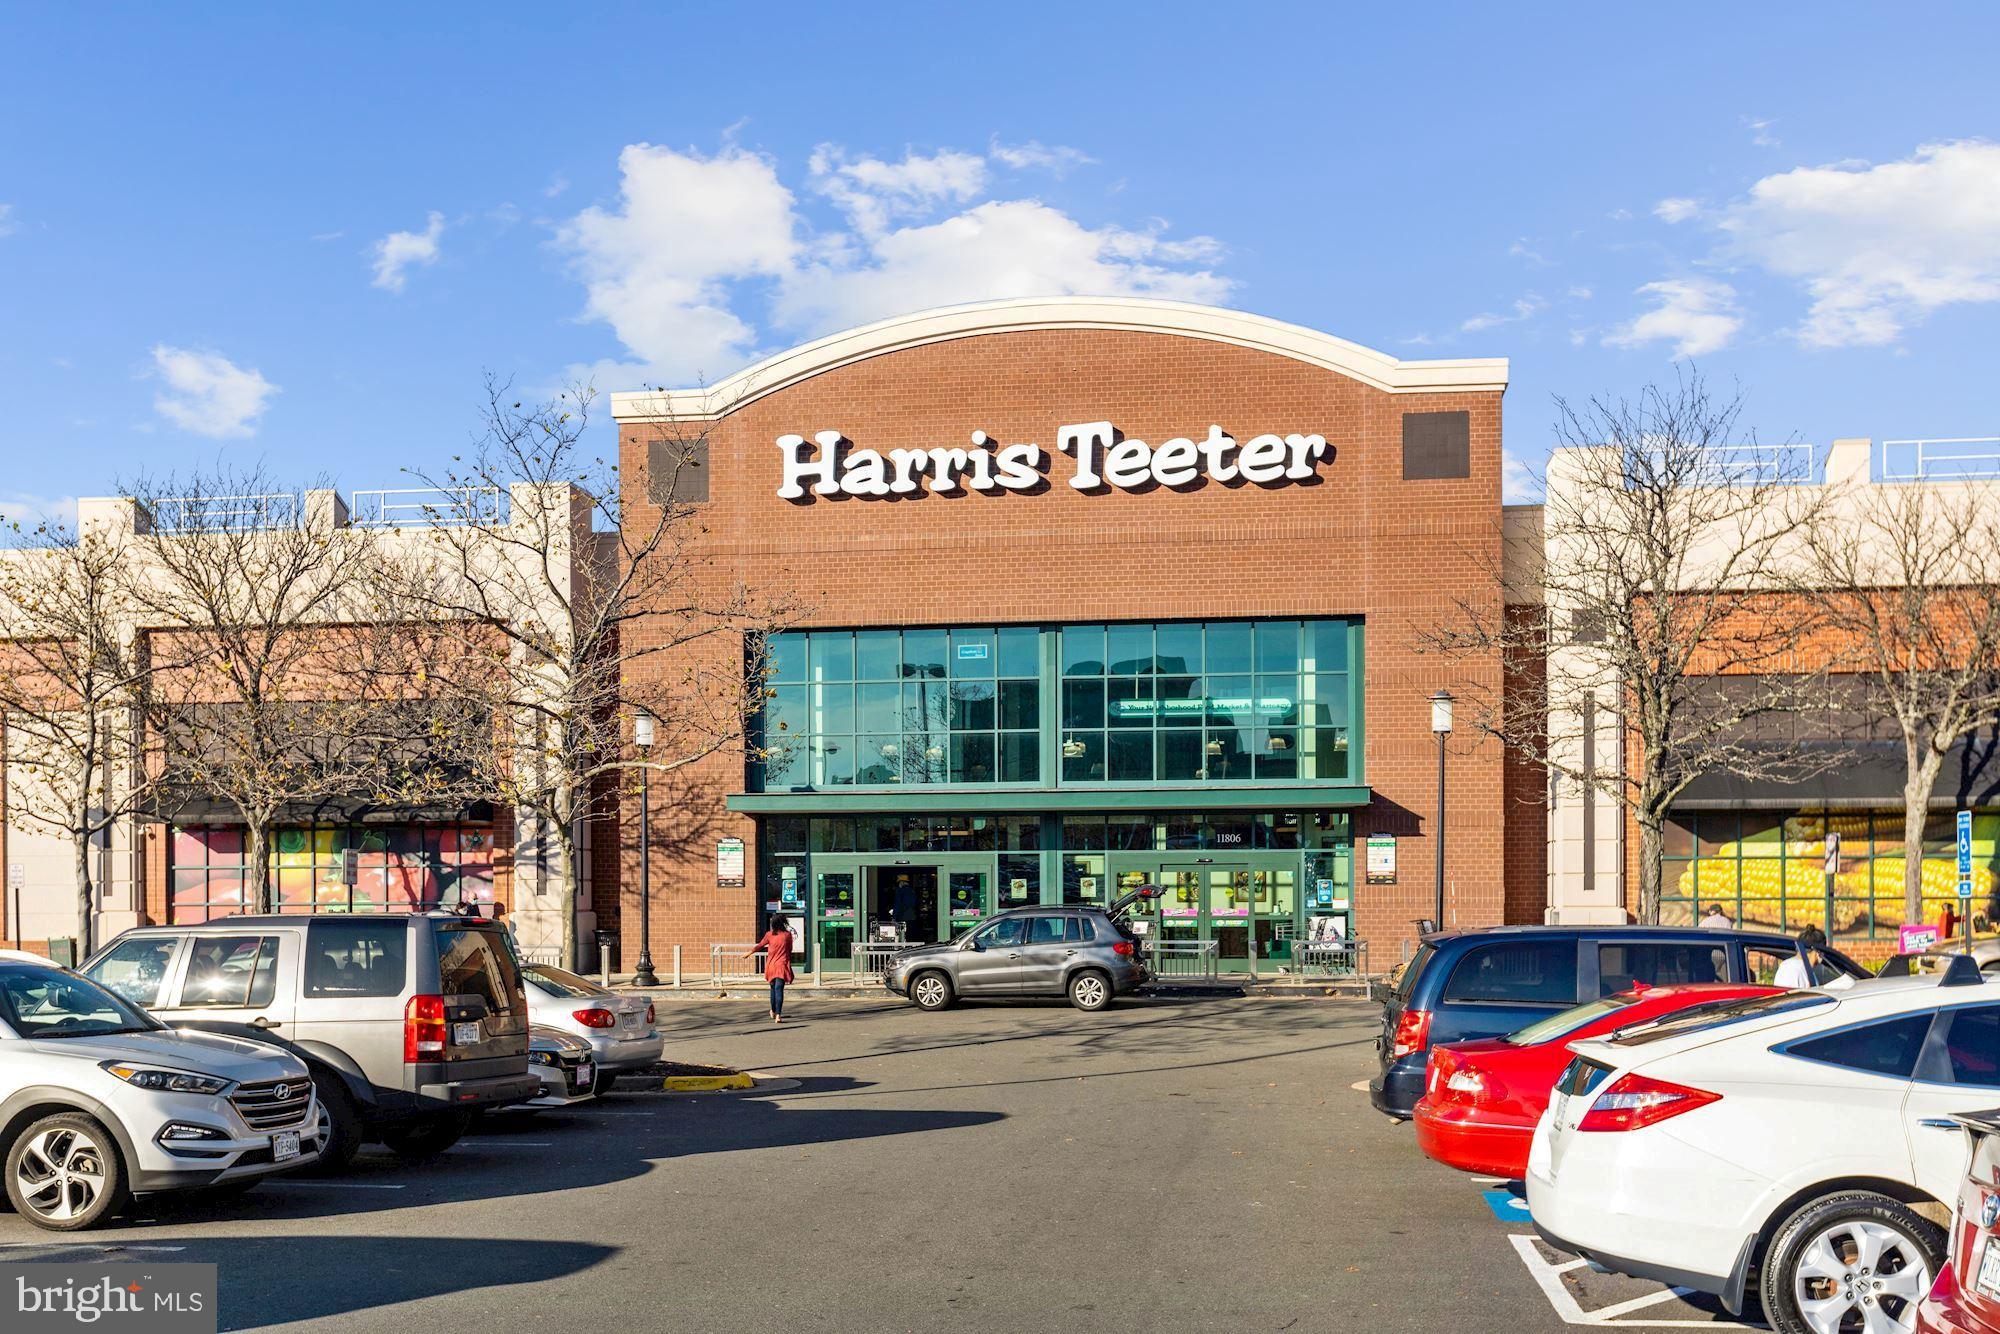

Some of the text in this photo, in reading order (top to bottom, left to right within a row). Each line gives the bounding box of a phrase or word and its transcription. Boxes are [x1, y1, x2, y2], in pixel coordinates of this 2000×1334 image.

[776, 421, 1326, 499] Harris Teeter
[1216, 833, 1242, 844] 11806
